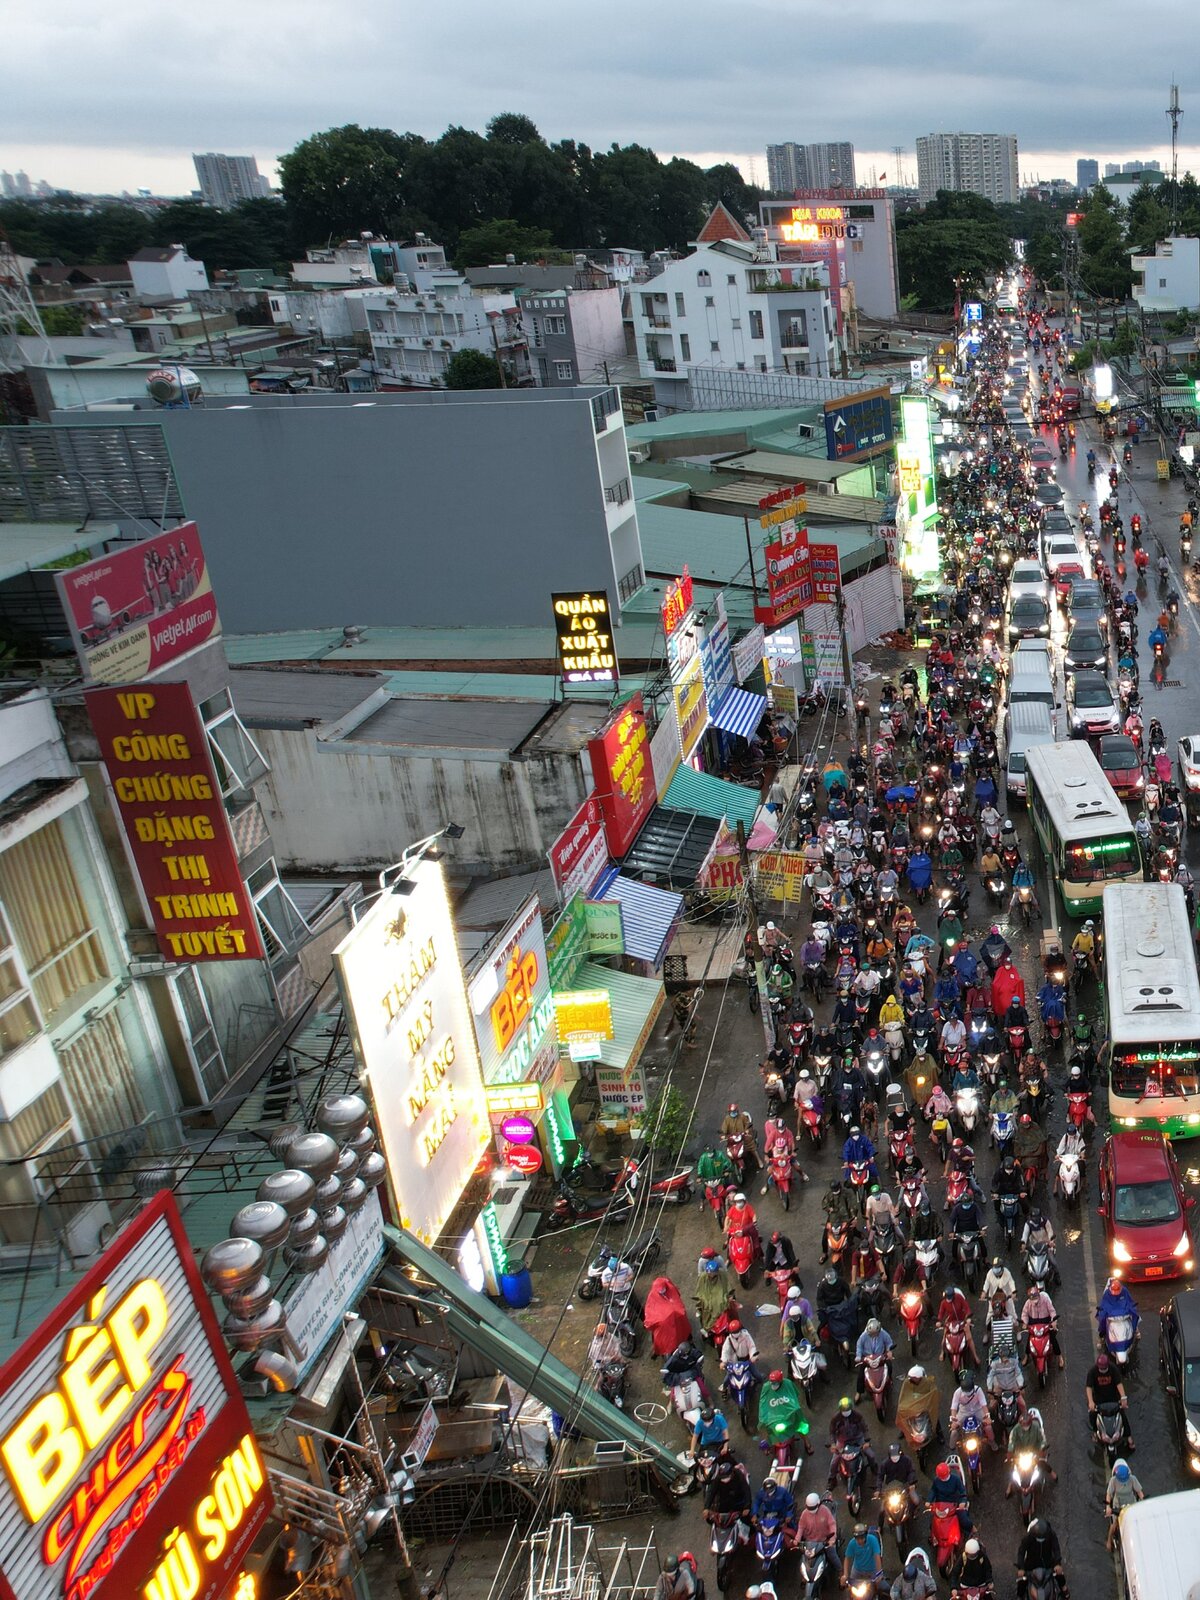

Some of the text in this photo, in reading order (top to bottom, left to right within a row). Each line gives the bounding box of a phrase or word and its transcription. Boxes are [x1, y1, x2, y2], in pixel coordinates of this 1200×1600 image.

[816, 583, 836, 592] LED
[555, 594, 606, 616] QUẦN
[571, 615, 596, 631] ÁO
[561, 630, 609, 649] XUẤT
[563, 649, 614, 669] KHẨU
[116, 693, 155, 719] VP
[112, 730, 191, 762] CÔNG
[115, 771, 213, 802] CHỨNG
[135, 811, 215, 848] ĐẶNG
[161, 855, 211, 886] THỊ
[154, 892, 239, 919] TRINH
[166, 922, 247, 957] TUYẾT
[491, 945, 539, 1056] BẾP
[601, 1083, 626, 1092] SINH
[602, 1093, 644, 1103] NƯỚC ÉP
[1148, 1084, 1157, 1094] 29
[1, 1278, 168, 1525] BẾP
[770, 1396, 790, 1407] Grab
[44, 1353, 188, 1566] CHEFS
[145, 1526, 200, 1600] VŨ
[196, 1434, 263, 1561] SƠN
